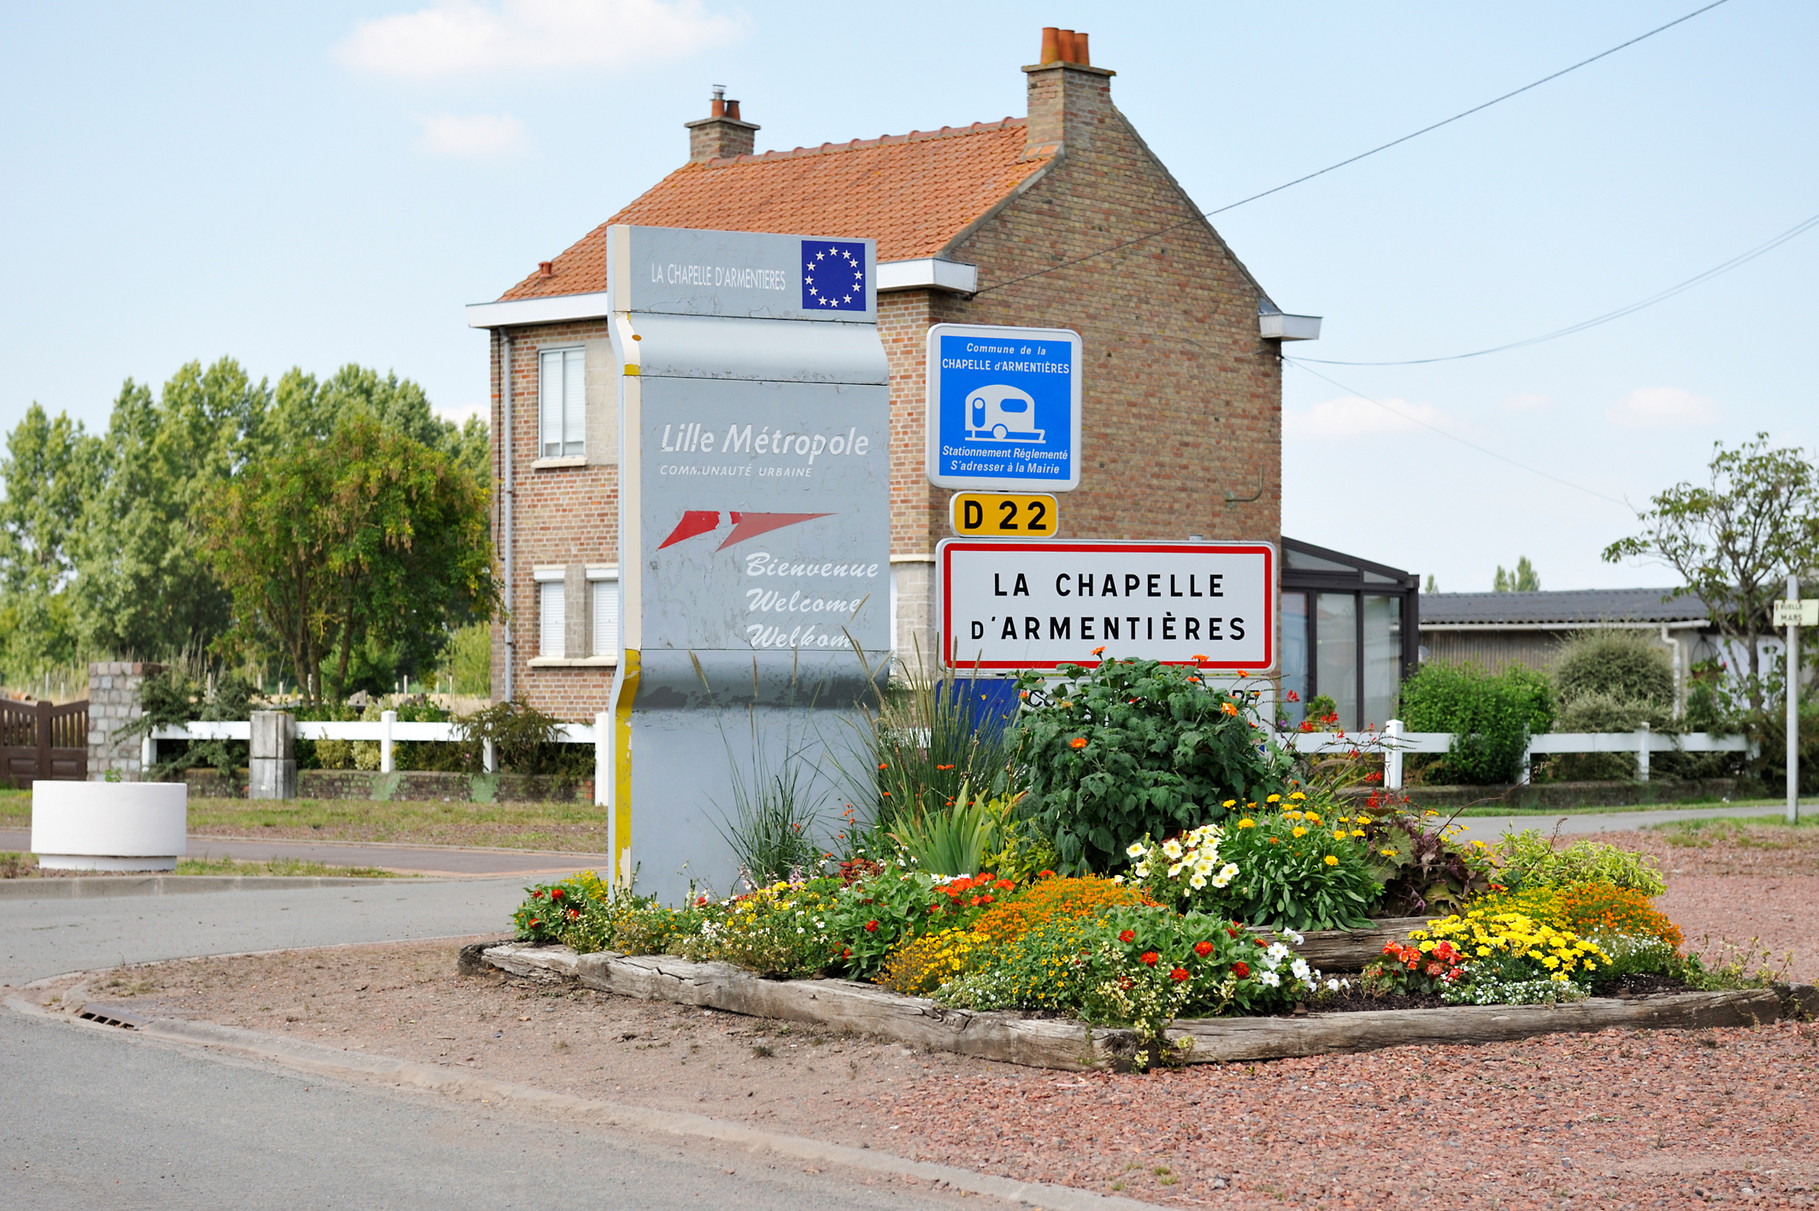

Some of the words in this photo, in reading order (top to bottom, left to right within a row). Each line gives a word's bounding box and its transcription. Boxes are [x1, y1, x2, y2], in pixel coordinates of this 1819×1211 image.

[651, 262, 664, 283] LA
[667, 264, 711, 286] CHAPELLE
[715, 266, 786, 291] D'ARMENTIERES
[966, 342, 1015, 354] Commune
[1020, 345, 1032, 355] de
[1037, 345, 1046, 356] la
[942, 358, 991, 371] CHAPELLE
[994, 361, 1069, 374] d'ARMENTIÈRES
[660, 422, 714, 453] Lille
[721, 423, 869, 465] Métropole
[942, 445, 1011, 458] Stationnement
[1013, 448, 1068, 462] Réglementé
[659, 463, 752, 477] COMMUNAUTÉ
[758, 467, 812, 477] URBAINE
[950, 460, 1004, 472] S'adresser
[1007, 462, 1013, 472] à
[1015, 462, 1024, 473] la
[1027, 463, 1059, 474] Mairie
[964, 500, 983, 530] D
[999, 500, 1046, 530] 22
[745, 552, 879, 578] Bienvenue
[994, 573, 1030, 596] LA
[1056, 573, 1224, 597] CHAPELLE
[745, 588, 862, 613] Welcome
[746, 624, 853, 648] Welkom
[971, 612, 1246, 641] D'ARMENTIÈRES
